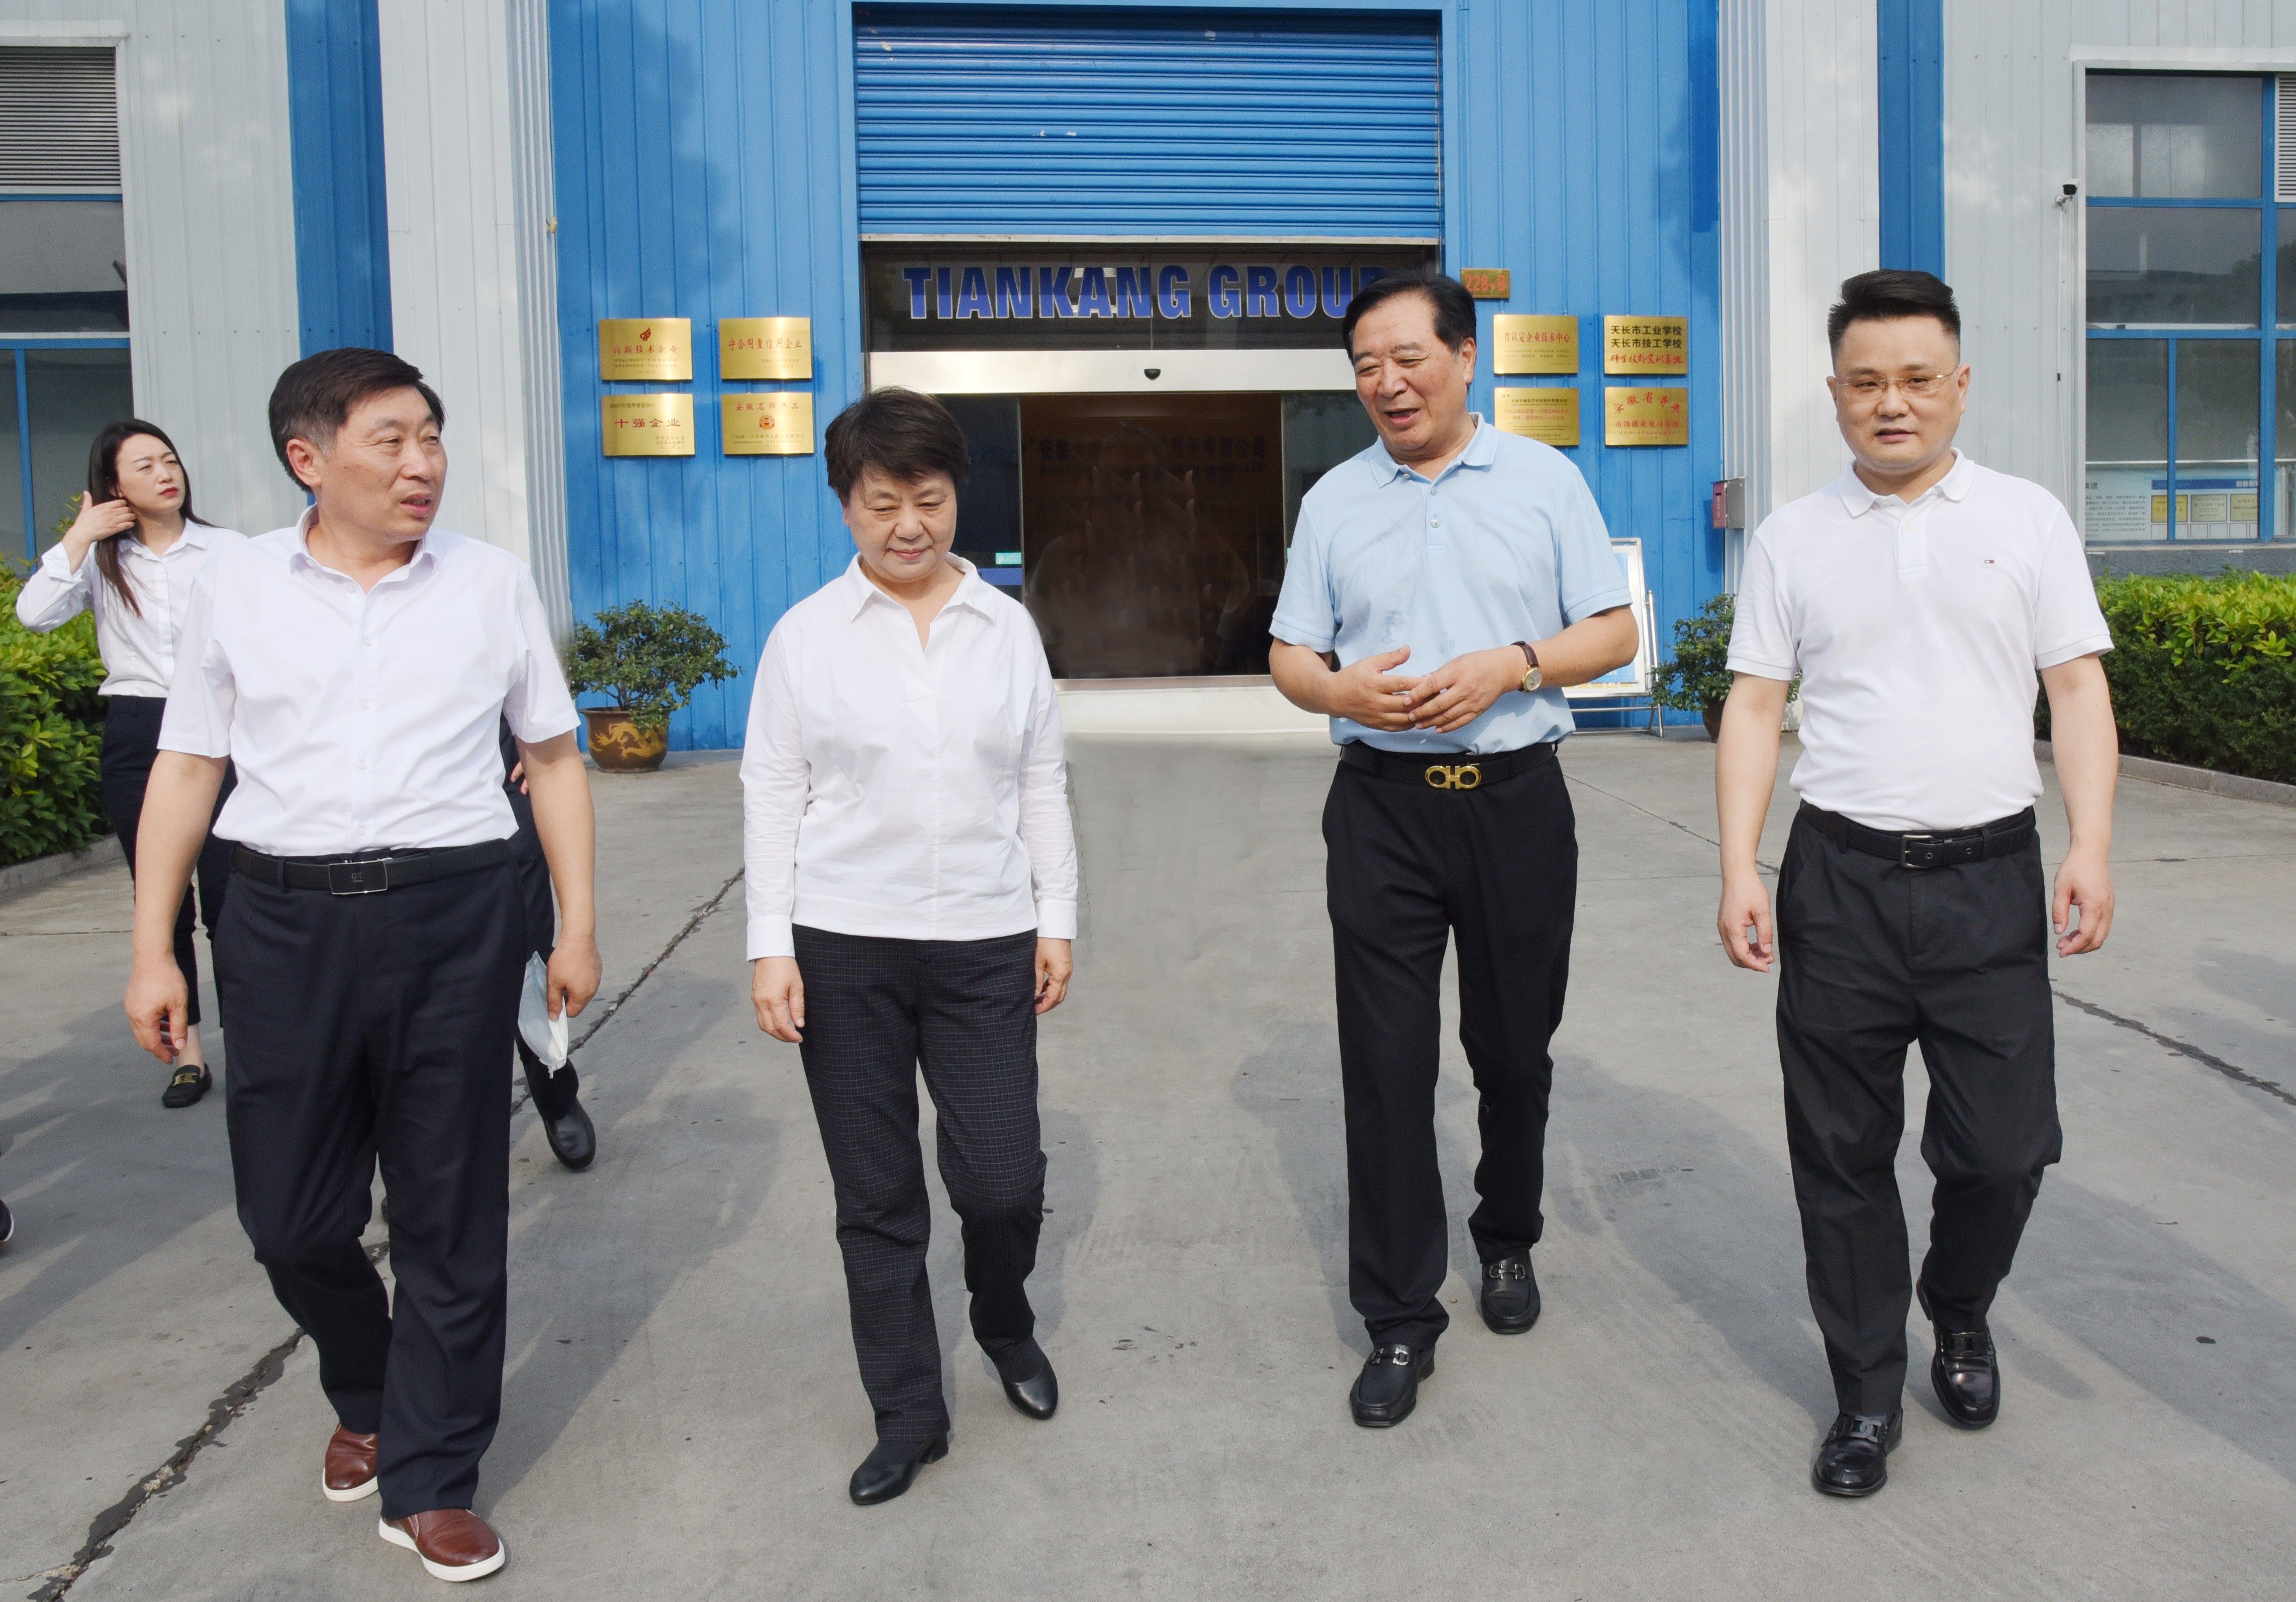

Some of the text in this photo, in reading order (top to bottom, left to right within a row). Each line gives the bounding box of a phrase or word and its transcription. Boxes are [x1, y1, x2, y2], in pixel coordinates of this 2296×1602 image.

[1465, 274, 1506, 292] 228-B
[903, 265, 1191, 319] TIANKANG
[1610, 325, 1682, 335] 天长市工业学校
[1504, 331, 1570, 343] 省认定企业技术中心
[728, 337, 802, 351] 守合同重信用企业
[1611, 338, 1682, 348] 天长市技工学校
[613, 344, 678, 354] 高新技术企业
[1610, 353, 1683, 364] 师生校外实训基地
[735, 402, 799, 411] 安徽名牌产品
[614, 418, 681, 428] 十强企业
